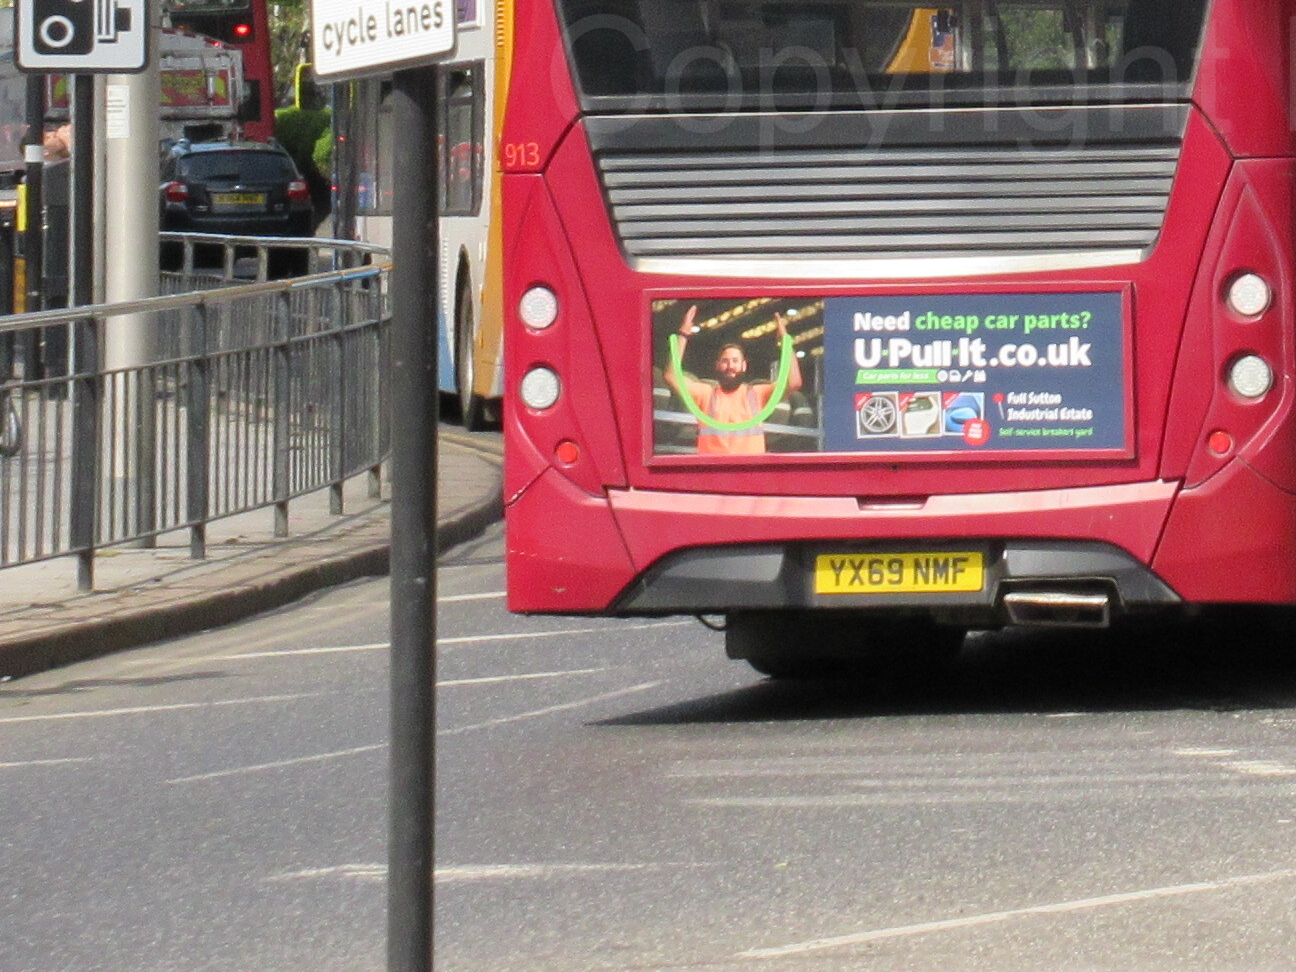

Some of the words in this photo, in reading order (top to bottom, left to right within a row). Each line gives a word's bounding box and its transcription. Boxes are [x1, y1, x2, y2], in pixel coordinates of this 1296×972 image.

[322, 6, 377, 56] cycle
[385, 1, 444, 38] lanes
[505, 142, 540, 167] 913
[854, 311, 911, 331] Need
[915, 311, 979, 335] cheap
[984, 314, 1020, 331] car
[1024, 311, 1092, 334] parts?
[1007, 392, 1025, 405] Full
[1027, 392, 1062, 405] Sutton
[1007, 406, 1058, 422] Industrial
[1060, 407, 1094, 421] Estate
[829, 558, 904, 586] YX69
[913, 556, 970, 585] NMF
